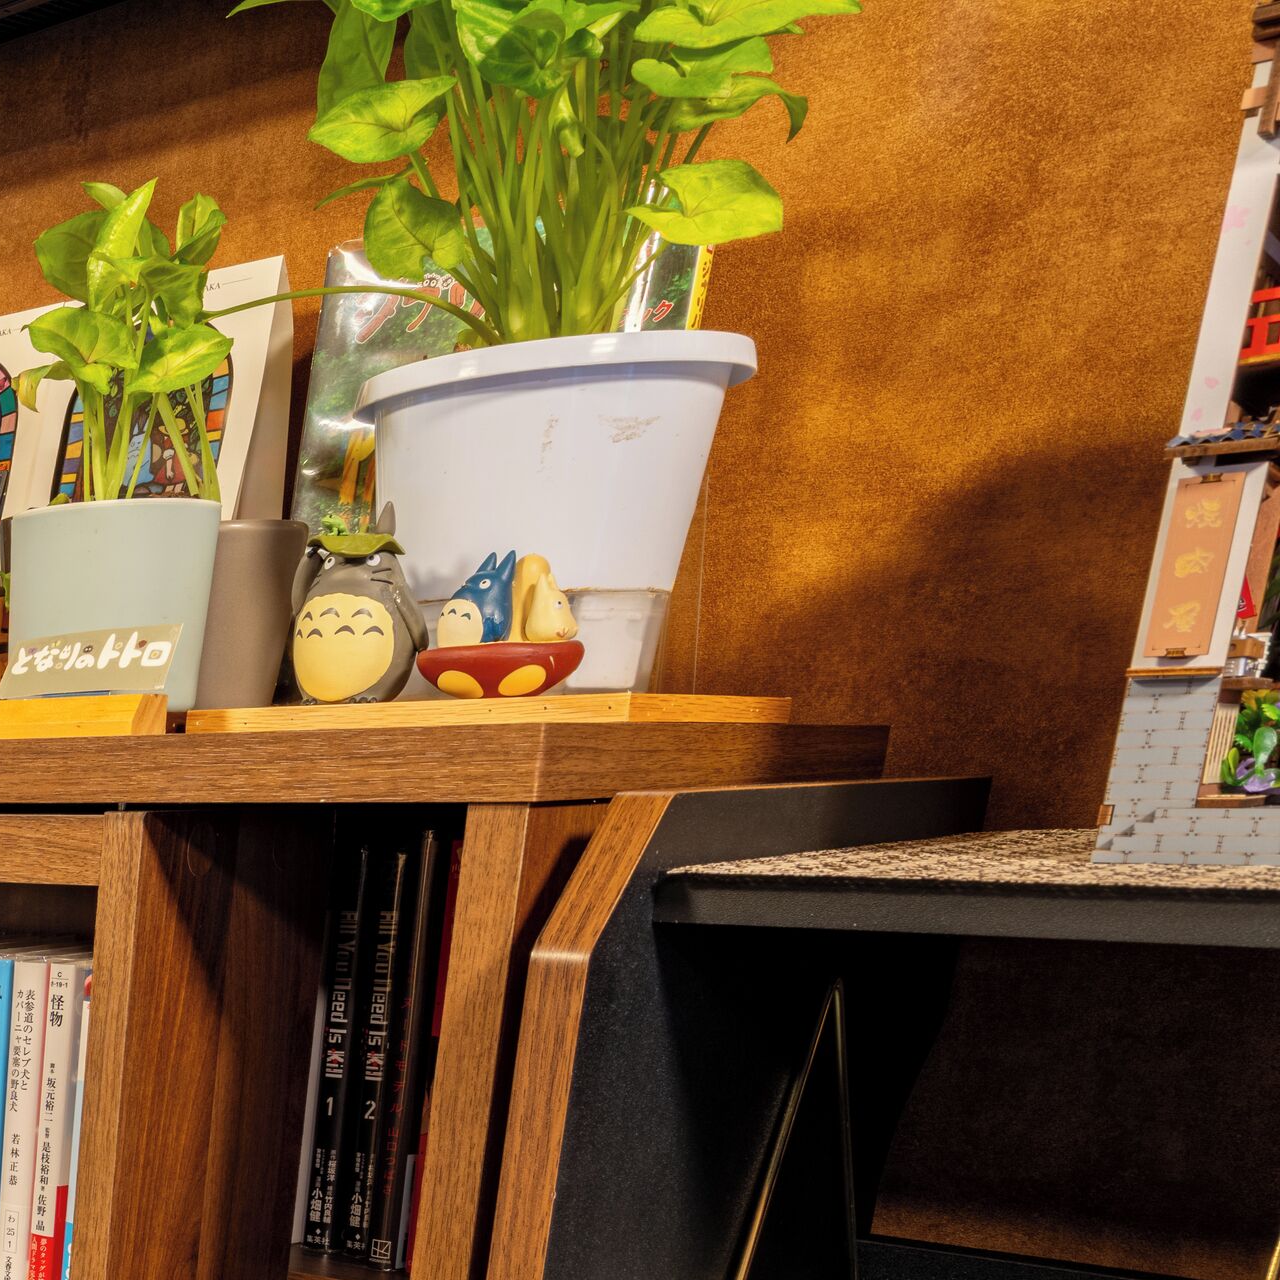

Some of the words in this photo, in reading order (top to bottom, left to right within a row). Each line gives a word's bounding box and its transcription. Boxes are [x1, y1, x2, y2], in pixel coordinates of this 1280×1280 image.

[11, 631, 173, 677] となりのトトロ
[49, 994, 65, 1027] 怪物
[9, 990, 24, 1112] カバーニャ要塞の野良犬
[20, 990, 36, 1091] 表参道のセレブ犬と
[325, 1050, 345, 1079] Kill
[364, 1052, 384, 1081] Kill
[44, 1078, 56, 1122] 坂元裕二
[326, 1096, 334, 1116] 1
[364, 1100, 376, 1119] 2
[8, 1134, 21, 1186] 若林正恭
[40, 1140, 52, 1186] 是枝裕和
[309, 1187, 323, 1223] 小畑健
[349, 1193, 363, 1228] 小畑健
[6, 1227, 15, 1236] 25
